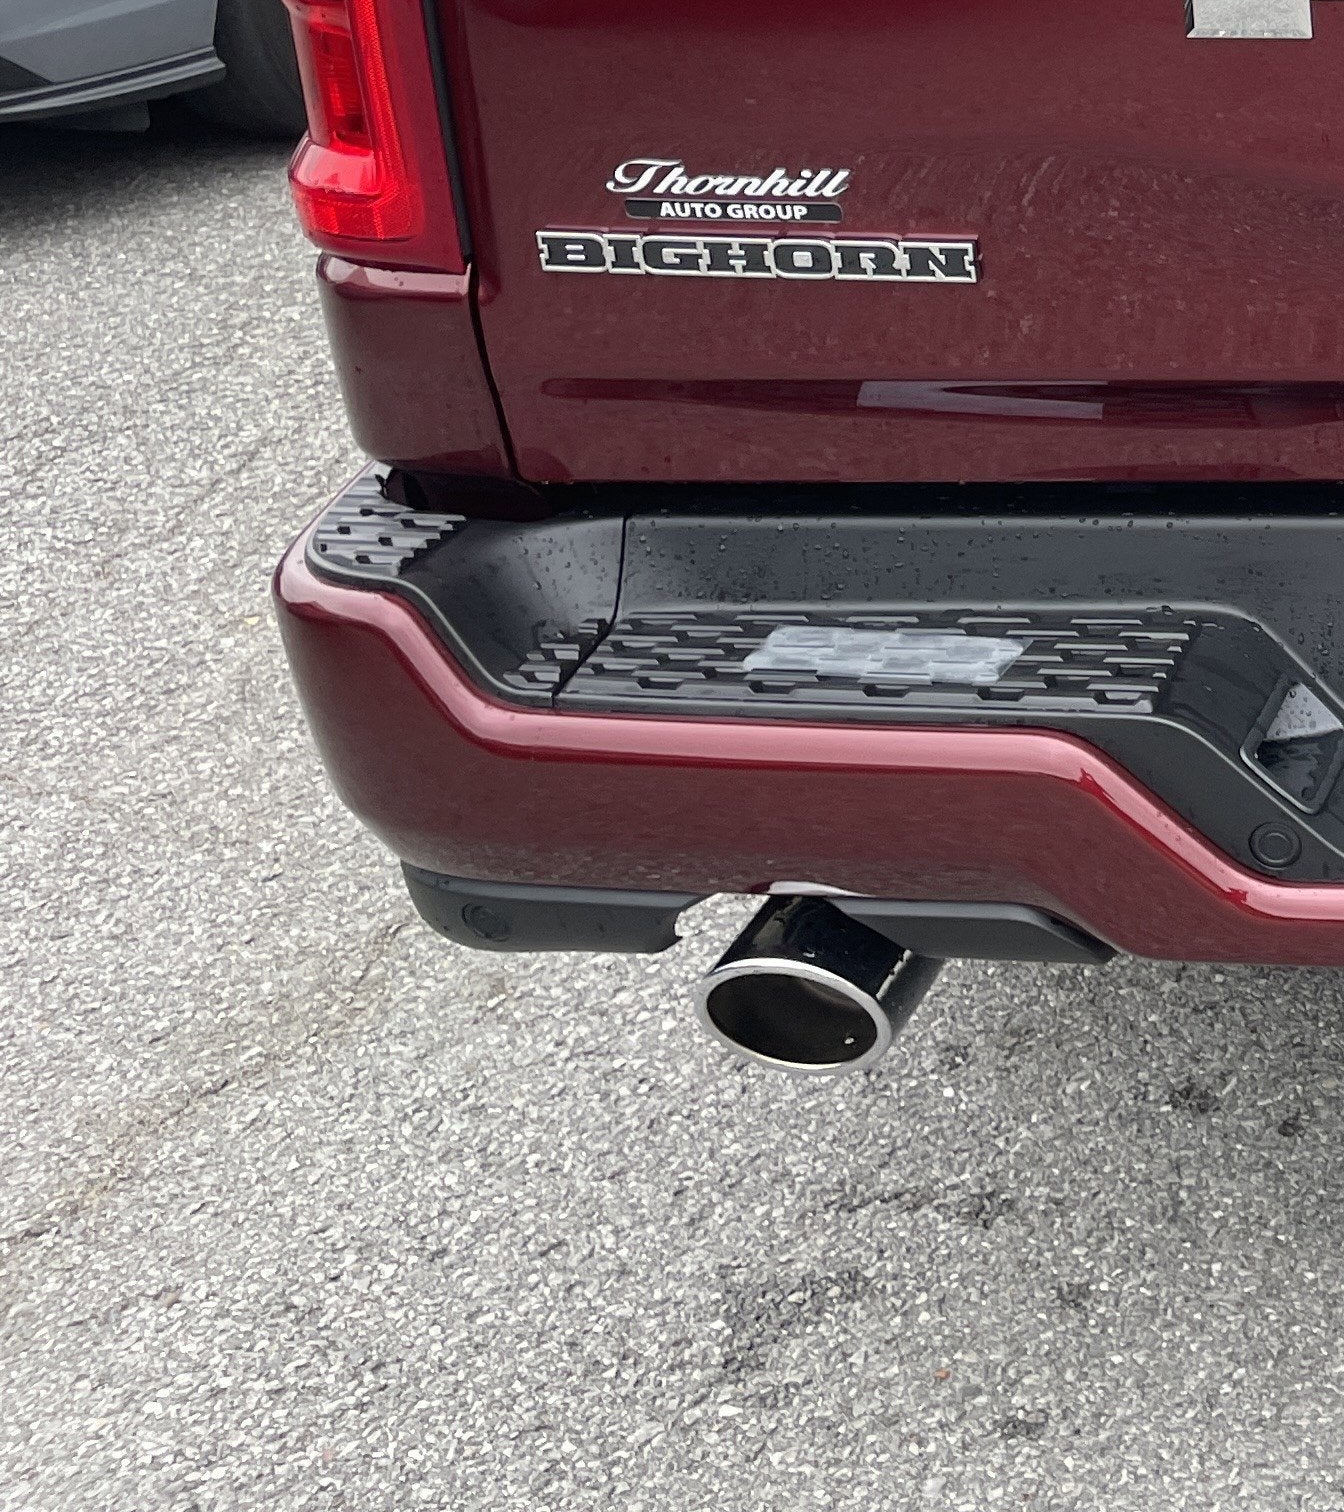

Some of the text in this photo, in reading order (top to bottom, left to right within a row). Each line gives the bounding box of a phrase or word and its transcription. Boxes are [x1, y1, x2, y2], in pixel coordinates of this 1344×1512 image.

[605, 157, 852, 199] Thornhill
[659, 201, 809, 221] AUTO GROUP
[535, 230, 985, 284] BIGHORN
